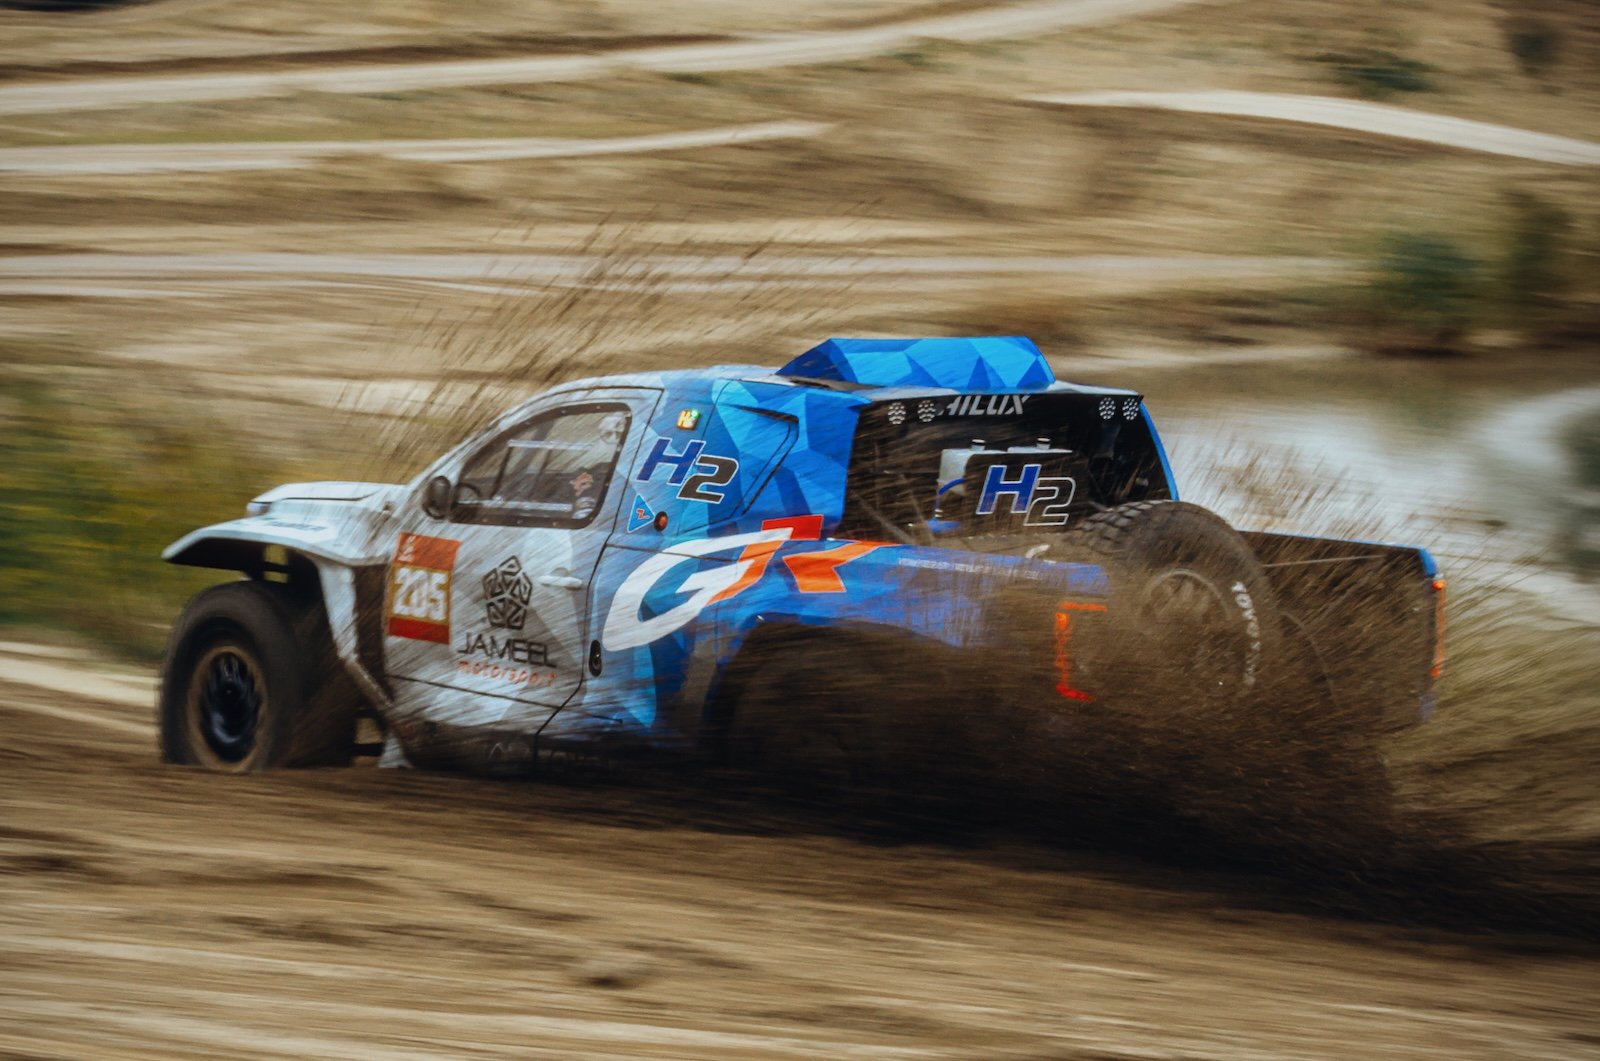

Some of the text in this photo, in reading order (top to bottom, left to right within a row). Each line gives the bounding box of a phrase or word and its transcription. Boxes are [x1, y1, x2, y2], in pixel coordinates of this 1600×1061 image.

[636, 437, 739, 504] H2
[976, 464, 1076, 526] H2
[392, 566, 449, 621] 205
[457, 632, 557, 668] JAMEEL
